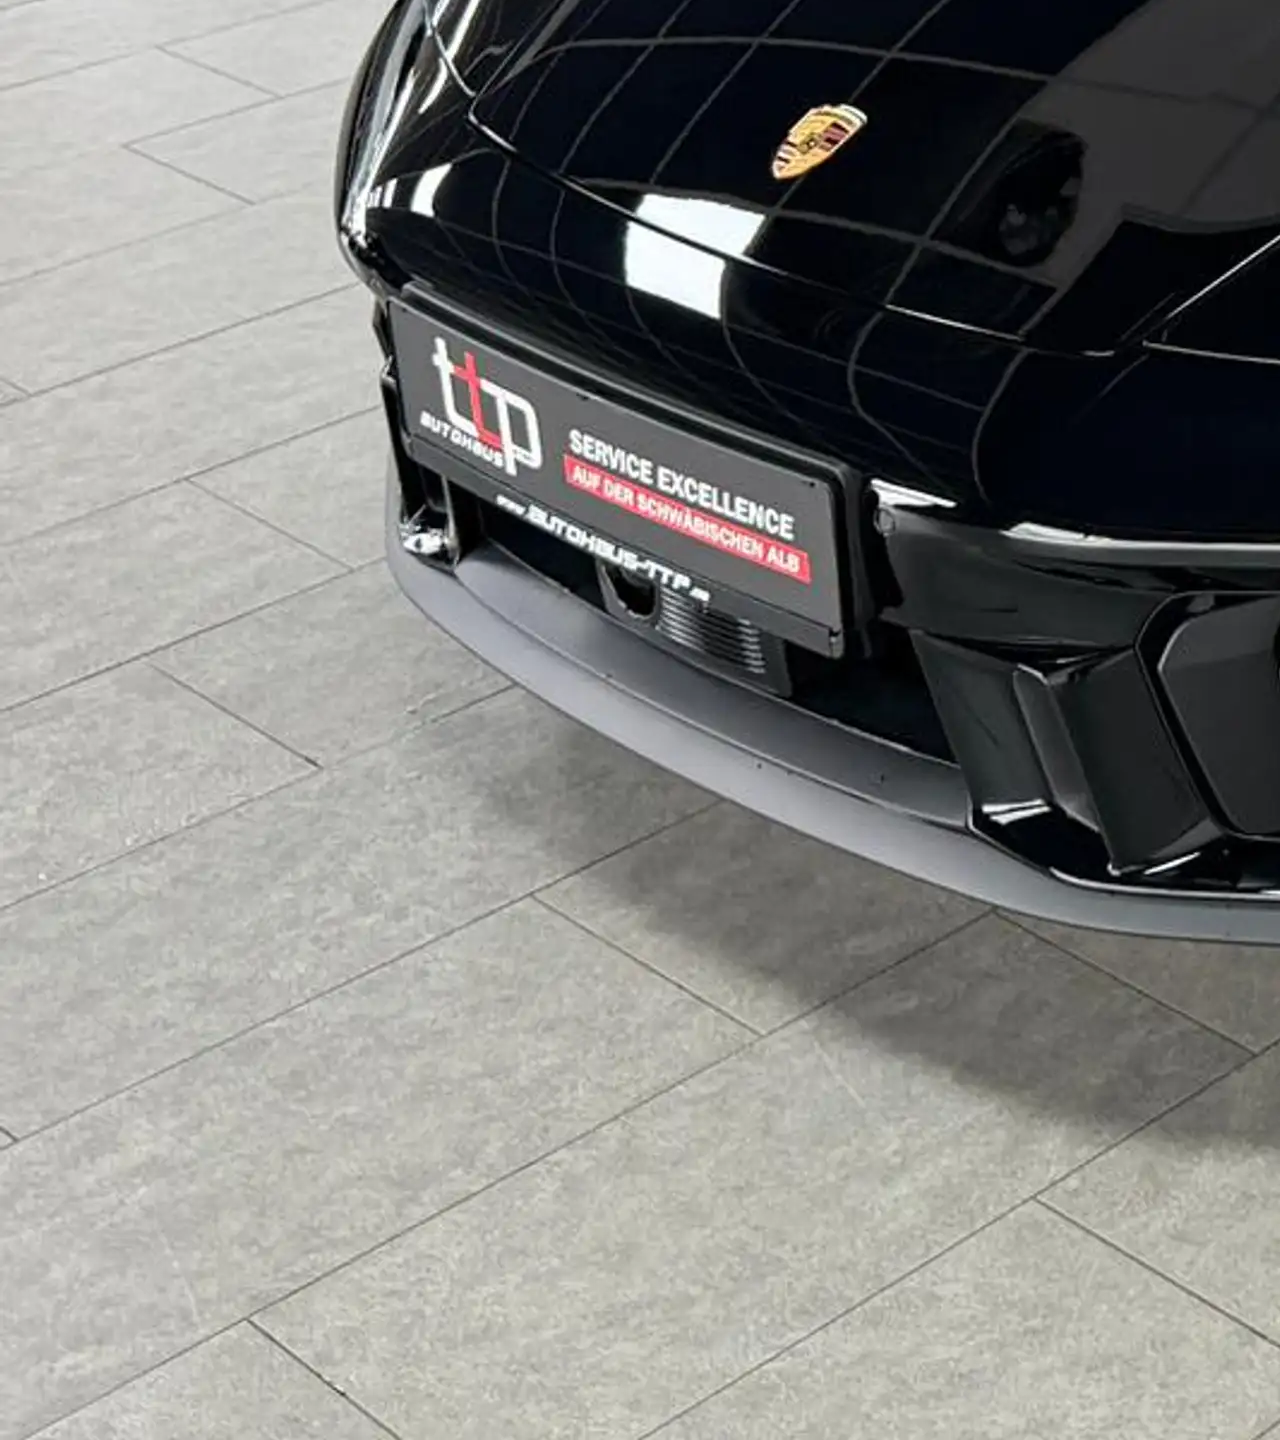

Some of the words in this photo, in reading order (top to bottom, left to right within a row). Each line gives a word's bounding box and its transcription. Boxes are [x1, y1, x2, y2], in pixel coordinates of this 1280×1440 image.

[420, 410, 505, 470] AUTOHAUS
[432, 337, 542, 477] ttp
[569, 429, 654, 485] SERVICE
[657, 465, 796, 542] EXCELLENCE
[573, 466, 601, 490] AUF
[603, 477, 635, 507] DER
[767, 545, 801, 574] ALB
